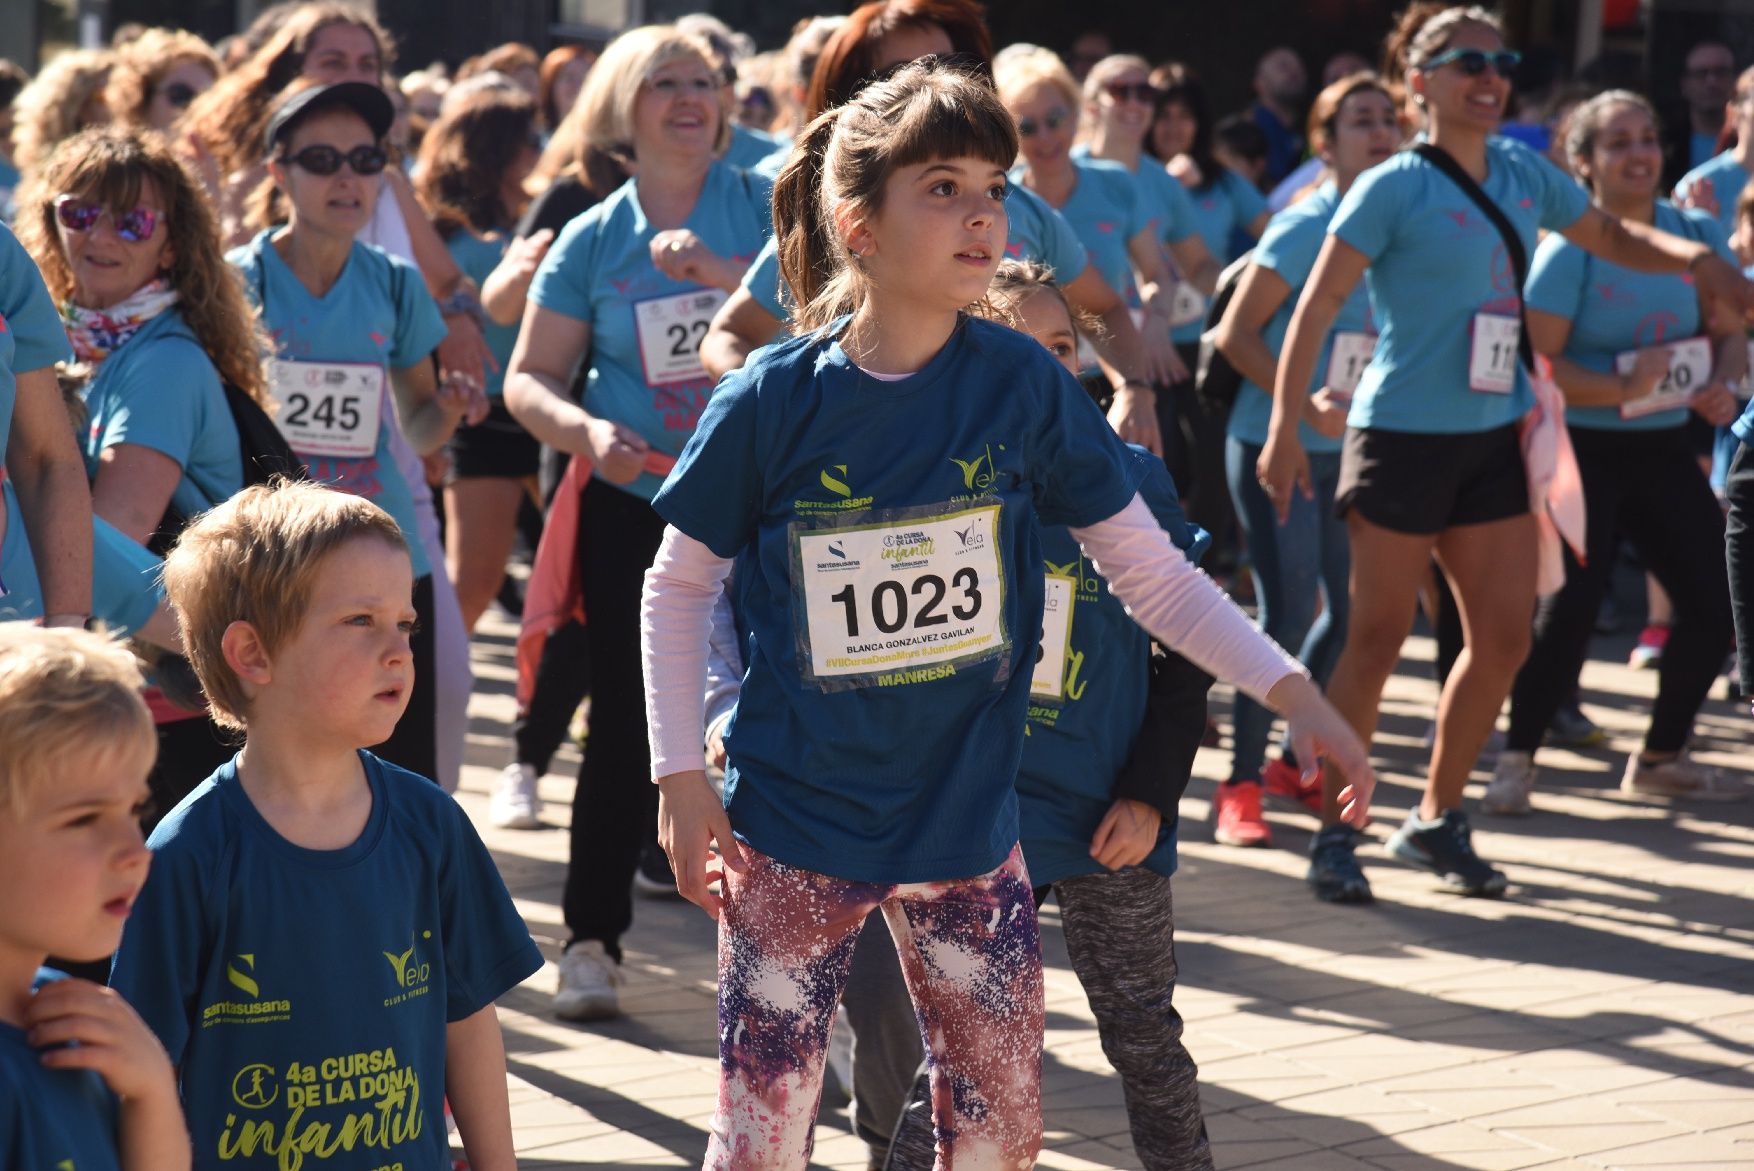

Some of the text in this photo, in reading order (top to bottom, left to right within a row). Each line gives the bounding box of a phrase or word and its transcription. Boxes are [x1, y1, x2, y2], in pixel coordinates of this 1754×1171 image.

[285, 392, 361, 431] 245
[904, 531, 924, 540] CURSA
[905, 537, 915, 545] LA
[953, 519, 984, 547] Vela
[881, 538, 936, 562] infantil
[816, 560, 861, 569] santasusana
[891, 560, 929, 569] santasusana
[832, 567, 983, 637] 1023
[847, 626, 975, 654] BLANCA GONZALVEZ GAVILAN
[878, 664, 957, 687] MANRESA
[383, 930, 430, 988] Vela
[203, 1000, 291, 1020] santasusana
[384, 995, 401, 1007] CLUB
[286, 1047, 397, 1084] 4a CURSA
[287, 1066, 415, 1109] DE LA DONA
[218, 1072, 424, 1171] infantil
